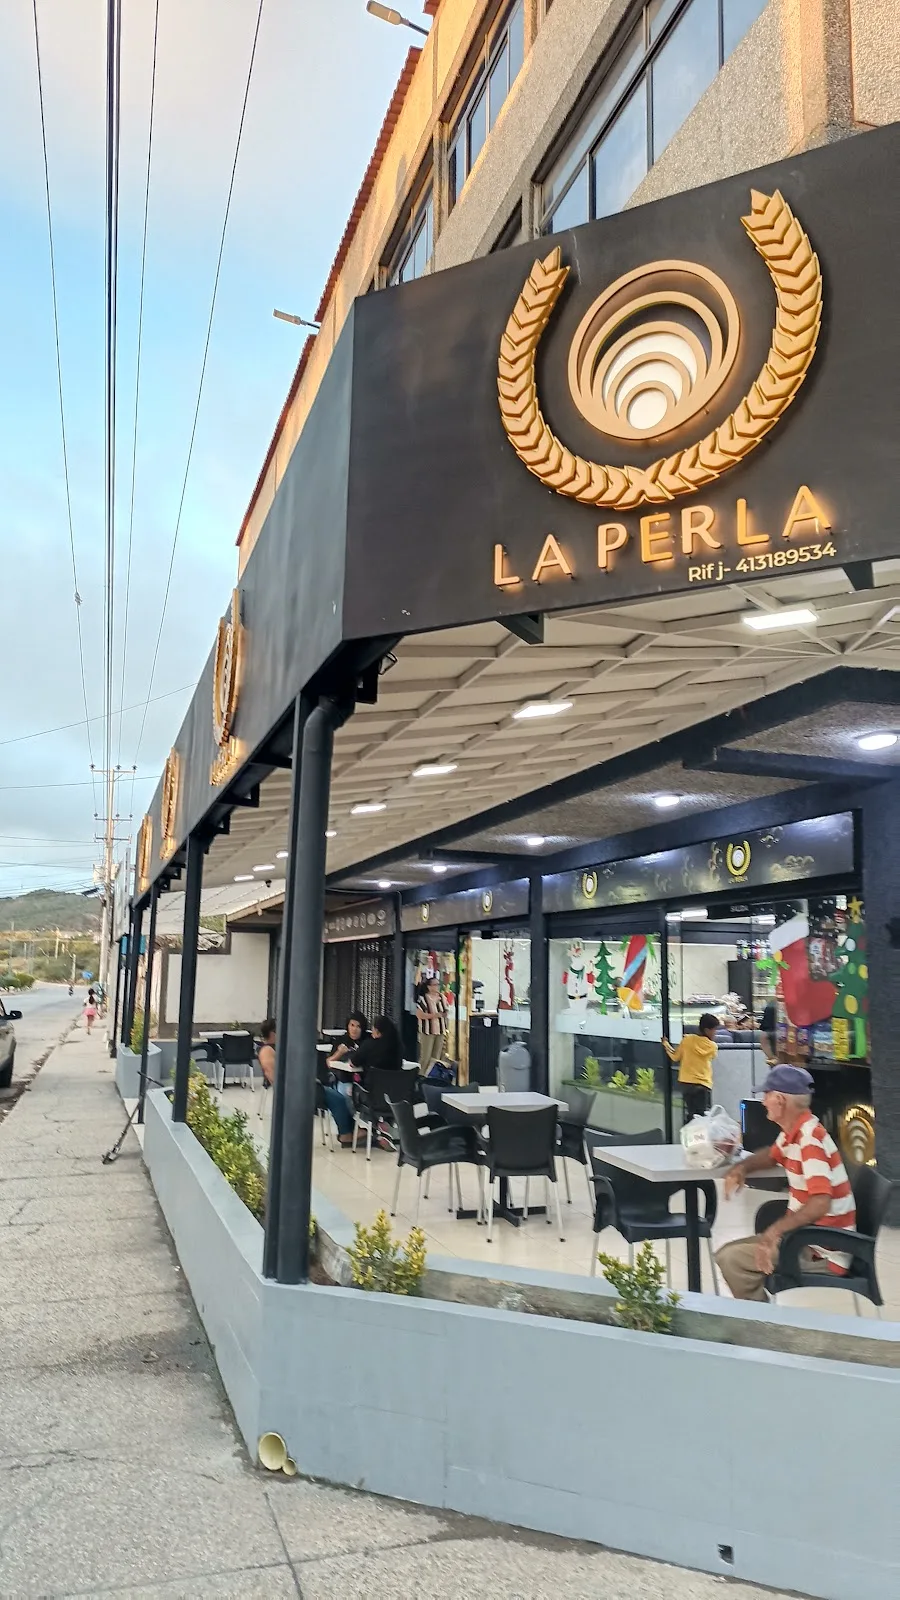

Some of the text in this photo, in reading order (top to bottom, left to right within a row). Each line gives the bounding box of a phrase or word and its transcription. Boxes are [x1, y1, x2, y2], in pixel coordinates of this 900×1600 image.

[494, 485, 832, 586] LA PERLA
[688, 562, 715, 582] Rif
[736, 542, 836, 573] 413189534
